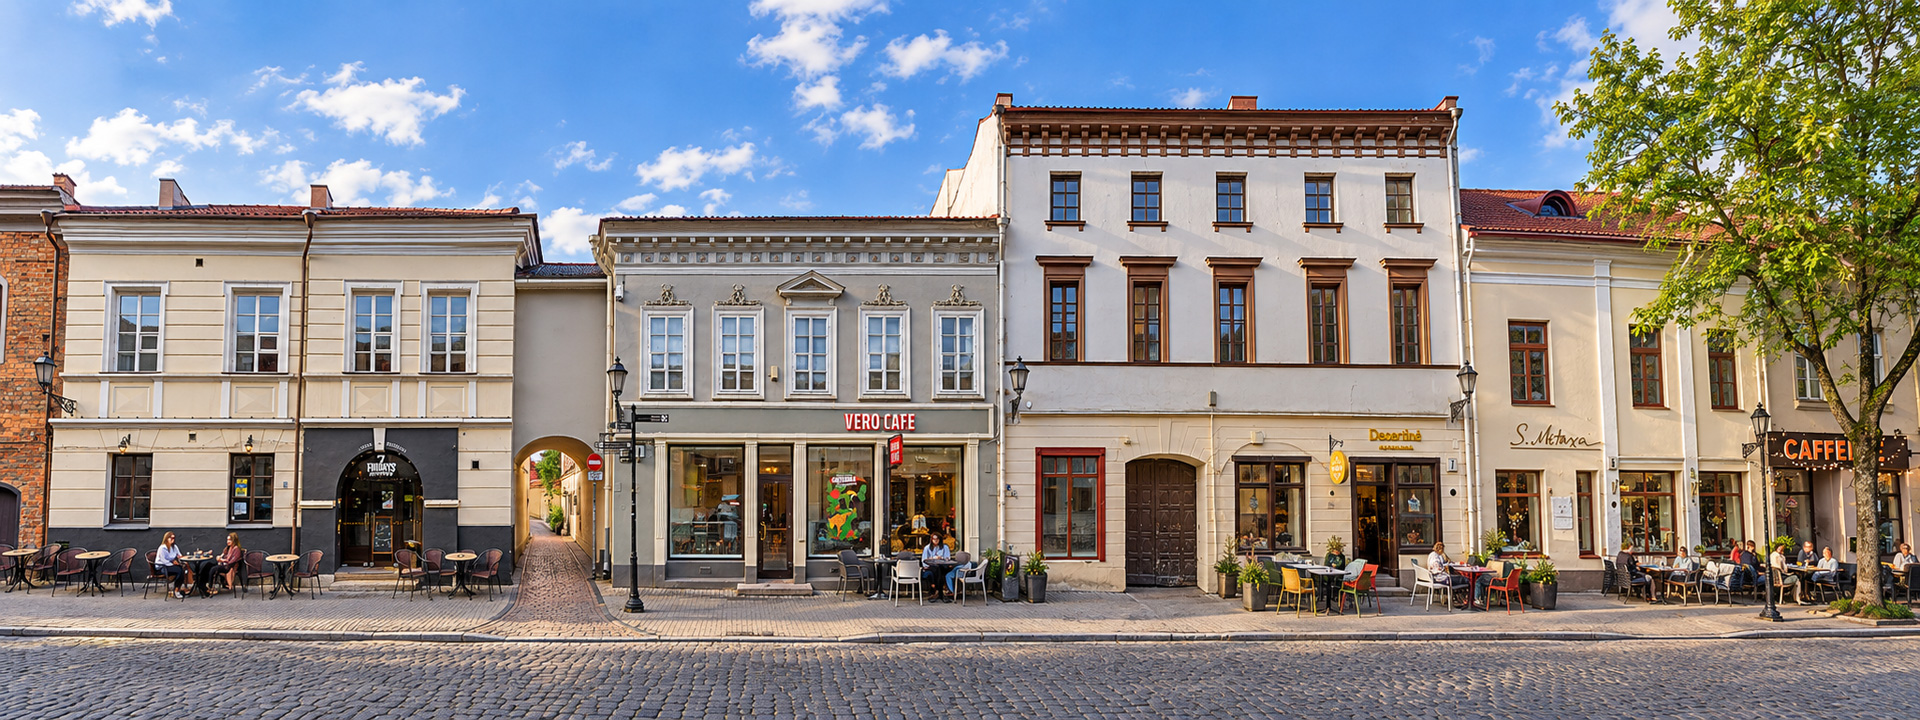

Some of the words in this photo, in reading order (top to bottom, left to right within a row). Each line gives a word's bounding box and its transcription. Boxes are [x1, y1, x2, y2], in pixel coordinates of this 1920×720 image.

[844, 413, 880, 430] VERO
[883, 413, 915, 430] CAFE
[376, 454, 386, 463] 7
